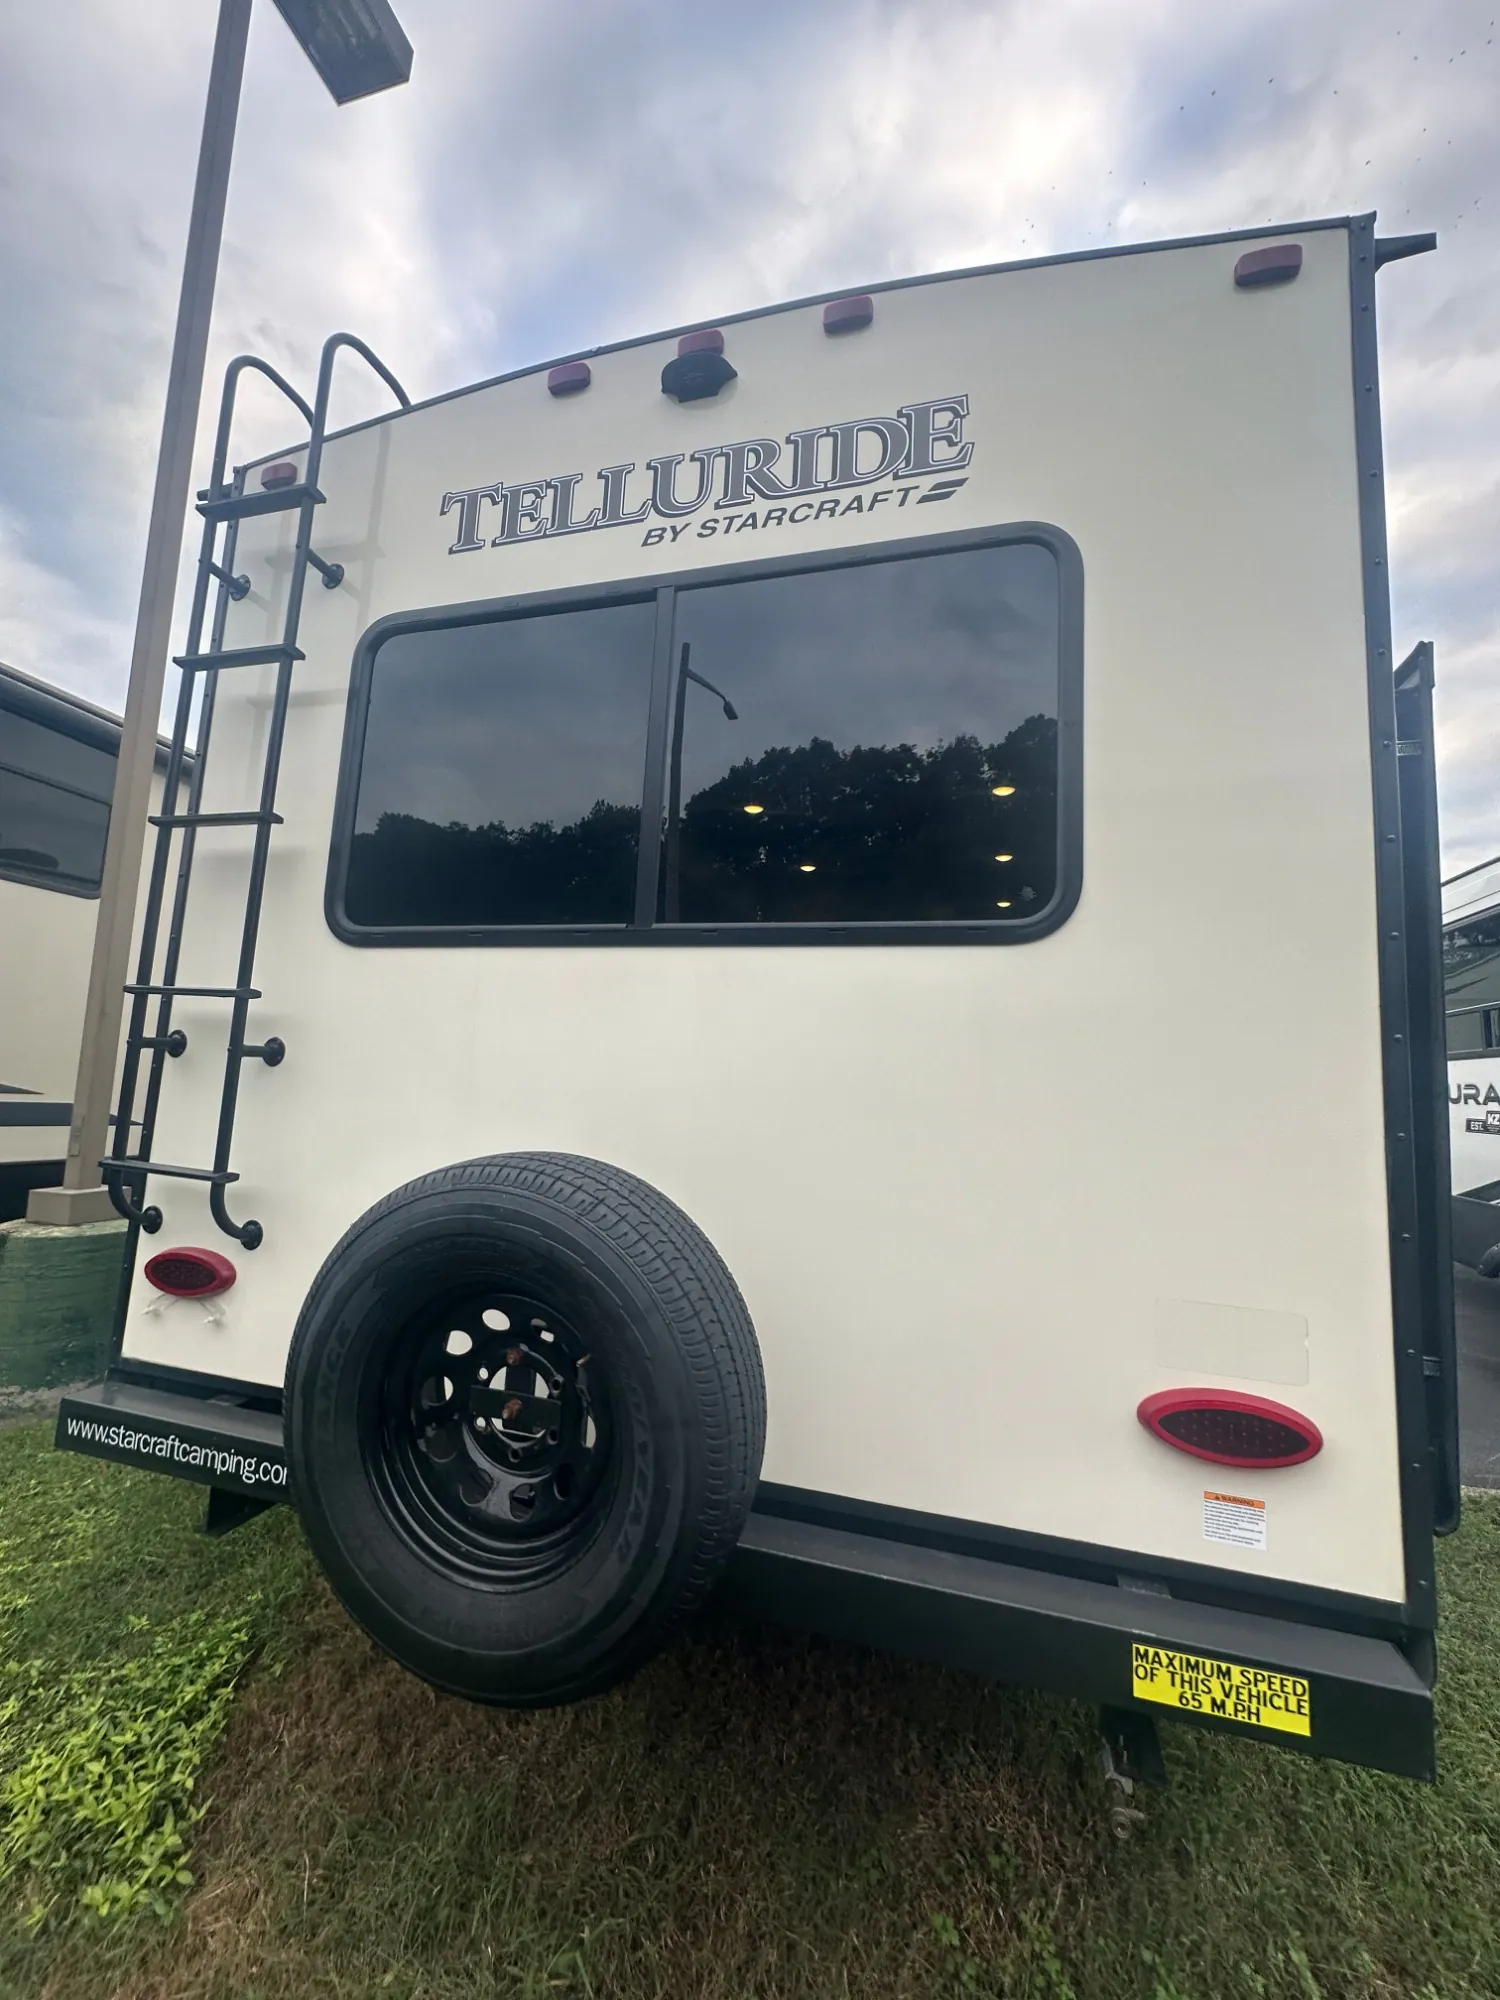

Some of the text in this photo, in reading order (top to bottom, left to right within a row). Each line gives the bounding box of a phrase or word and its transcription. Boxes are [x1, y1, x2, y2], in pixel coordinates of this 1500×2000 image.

[439, 393, 975, 554] TELLURIDE
[640, 485, 919, 547] BY STARCRAFT
[1487, 1113, 1500, 1125] KZ
[1134, 1646, 1307, 1697] MAXIMUM SPEED
[1134, 1664, 1308, 1716] OF THIS VEHICLE
[1178, 1690, 1261, 1723] 65 M.P.H
